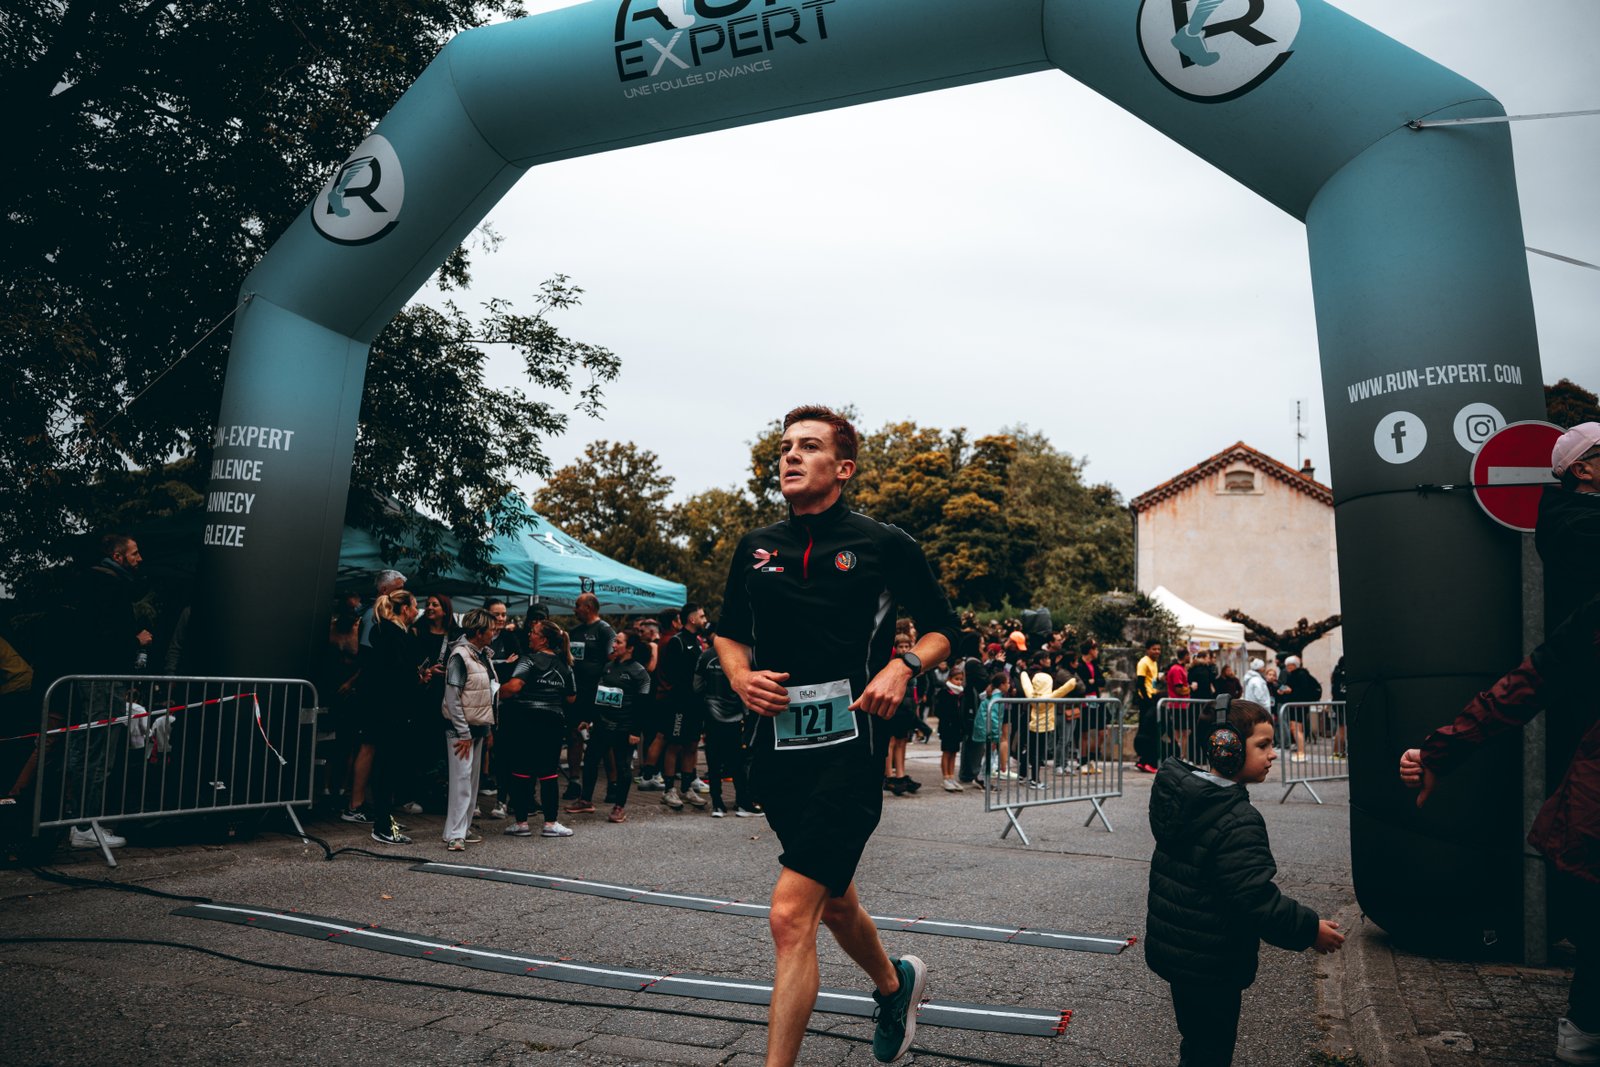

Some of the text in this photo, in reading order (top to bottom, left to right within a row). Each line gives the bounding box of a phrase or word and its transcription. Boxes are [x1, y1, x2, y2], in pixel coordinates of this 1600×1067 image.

[614, 0, 836, 82] EXPERT
[624, 59, 773, 99] UNE FOULÉE D'AVANCE
[206, 491, 256, 515] ANNECY
[203, 524, 246, 548] GLEIZE
[789, 701, 834, 737] 127
